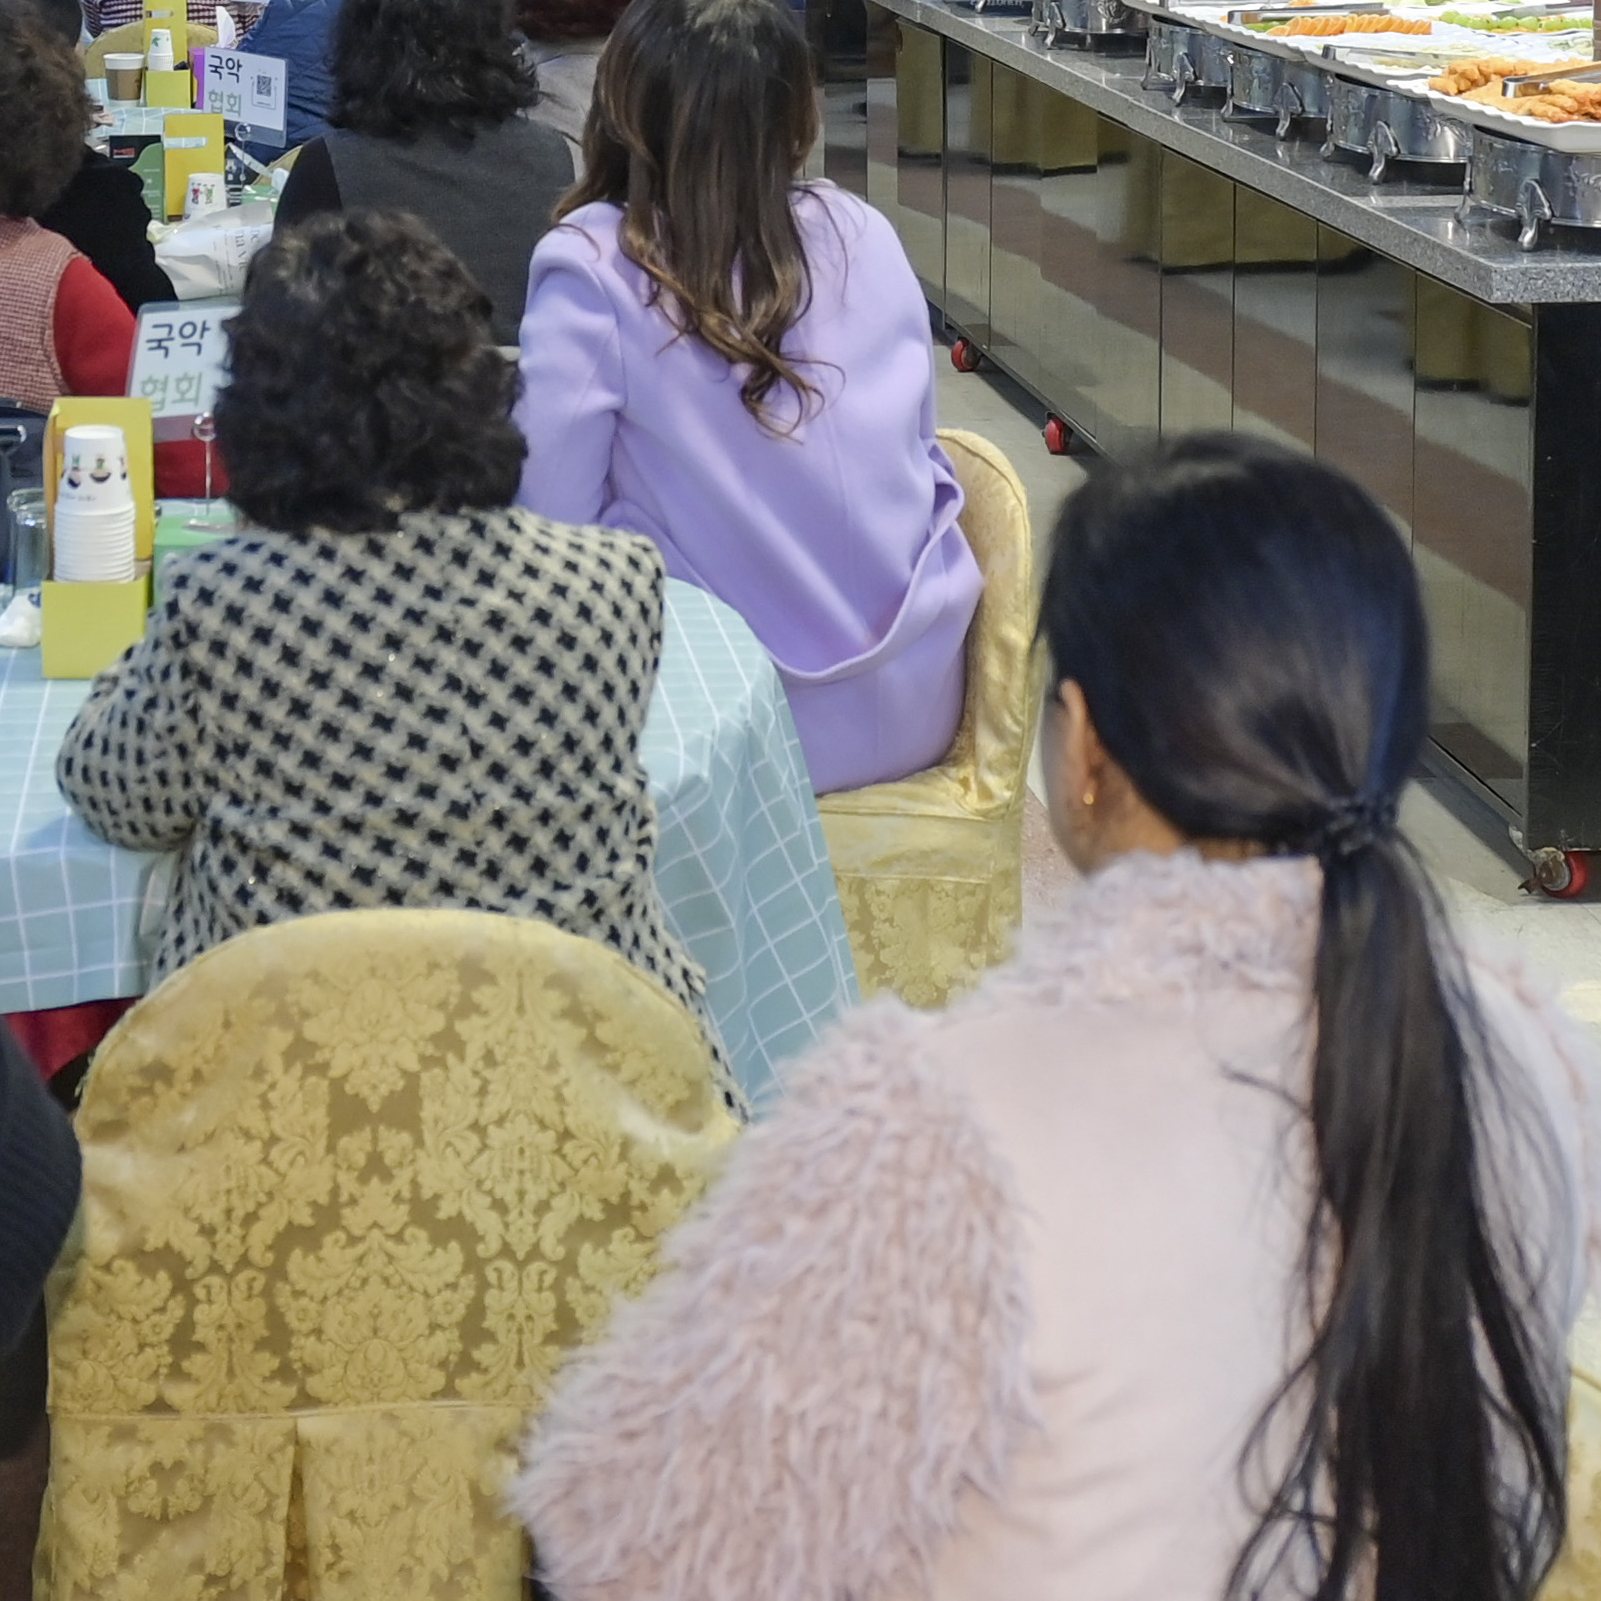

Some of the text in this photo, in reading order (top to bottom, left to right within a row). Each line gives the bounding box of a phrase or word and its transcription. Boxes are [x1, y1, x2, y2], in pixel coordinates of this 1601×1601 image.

[208, 54, 242, 84] 국악
[208, 88, 242, 117] 협회
[145, 320, 211, 359] 국악
[140, 370, 203, 413] 협회
